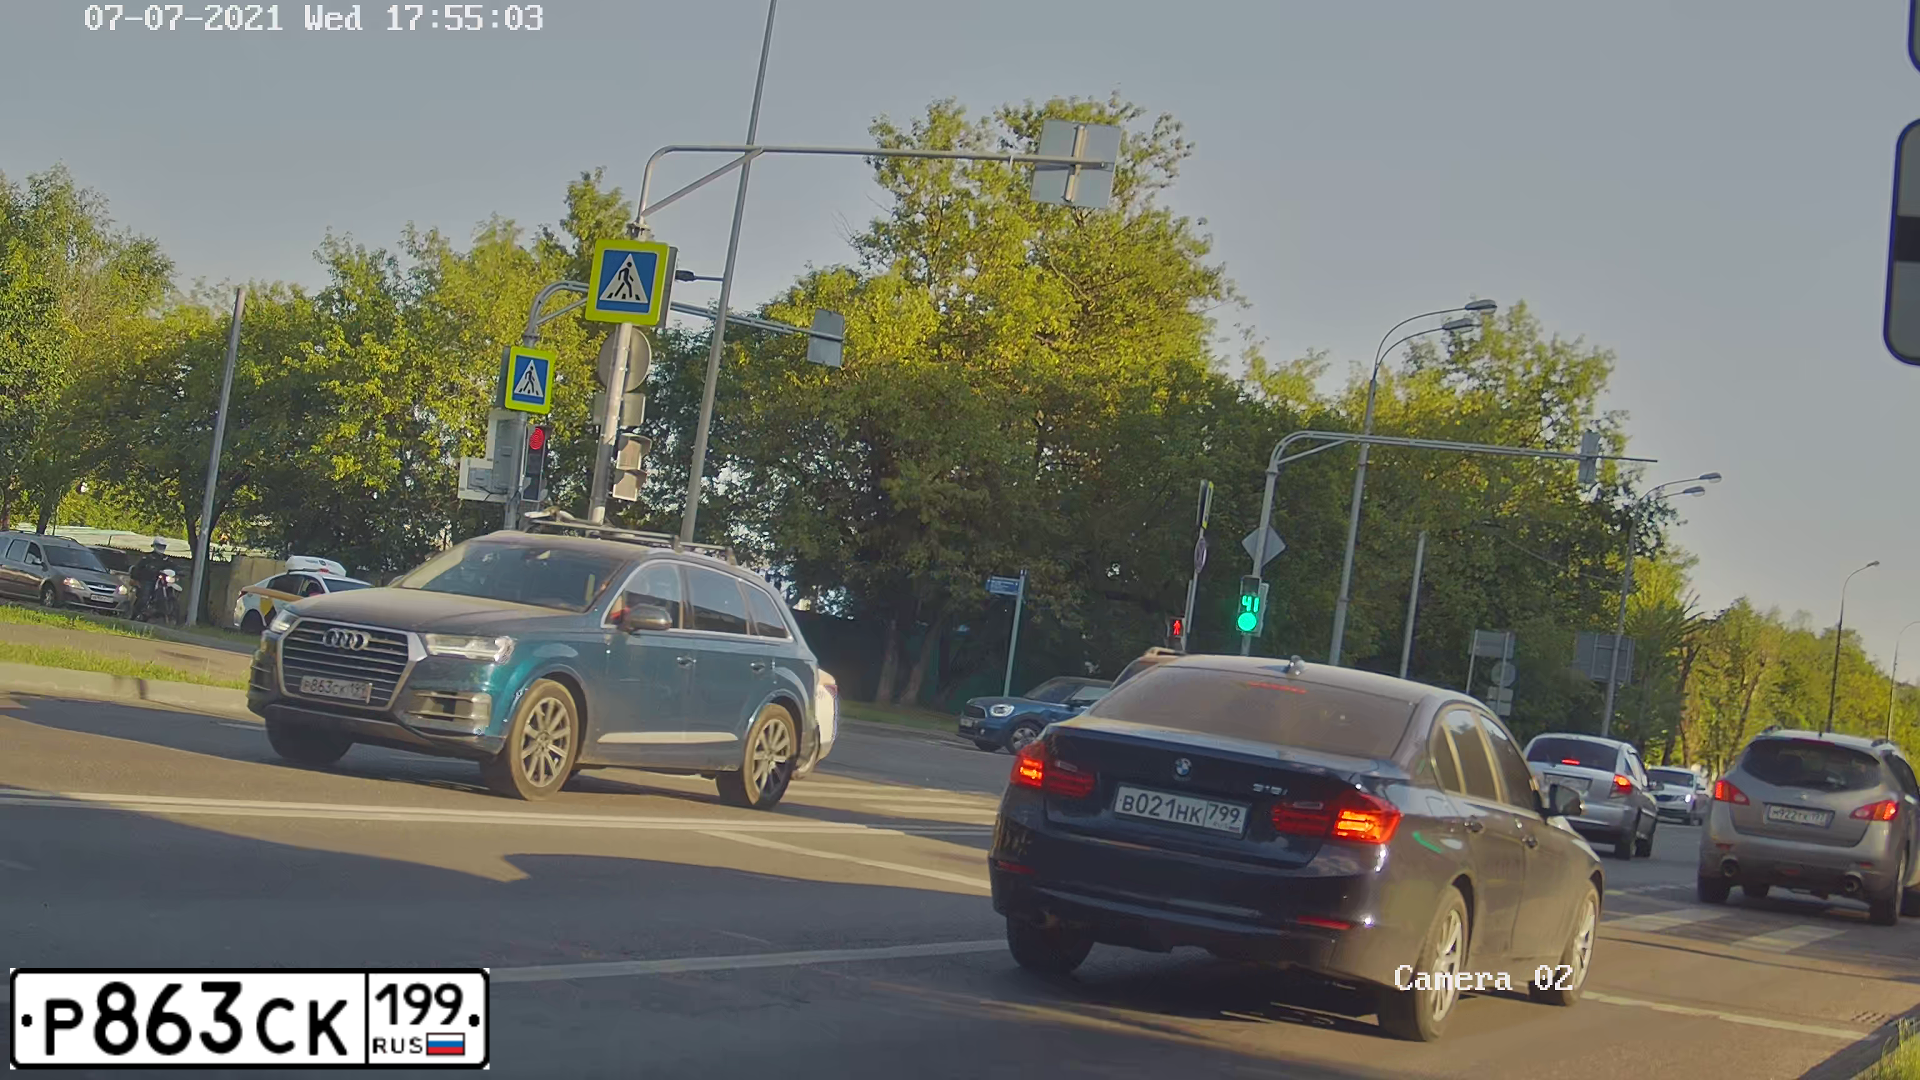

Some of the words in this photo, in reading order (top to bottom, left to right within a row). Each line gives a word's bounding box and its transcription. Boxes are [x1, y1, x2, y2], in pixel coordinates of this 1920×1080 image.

[1242, 595, 1260, 613] 41
[1122, 793, 1203, 823] B021HK
[1208, 803, 1240, 823] 799
